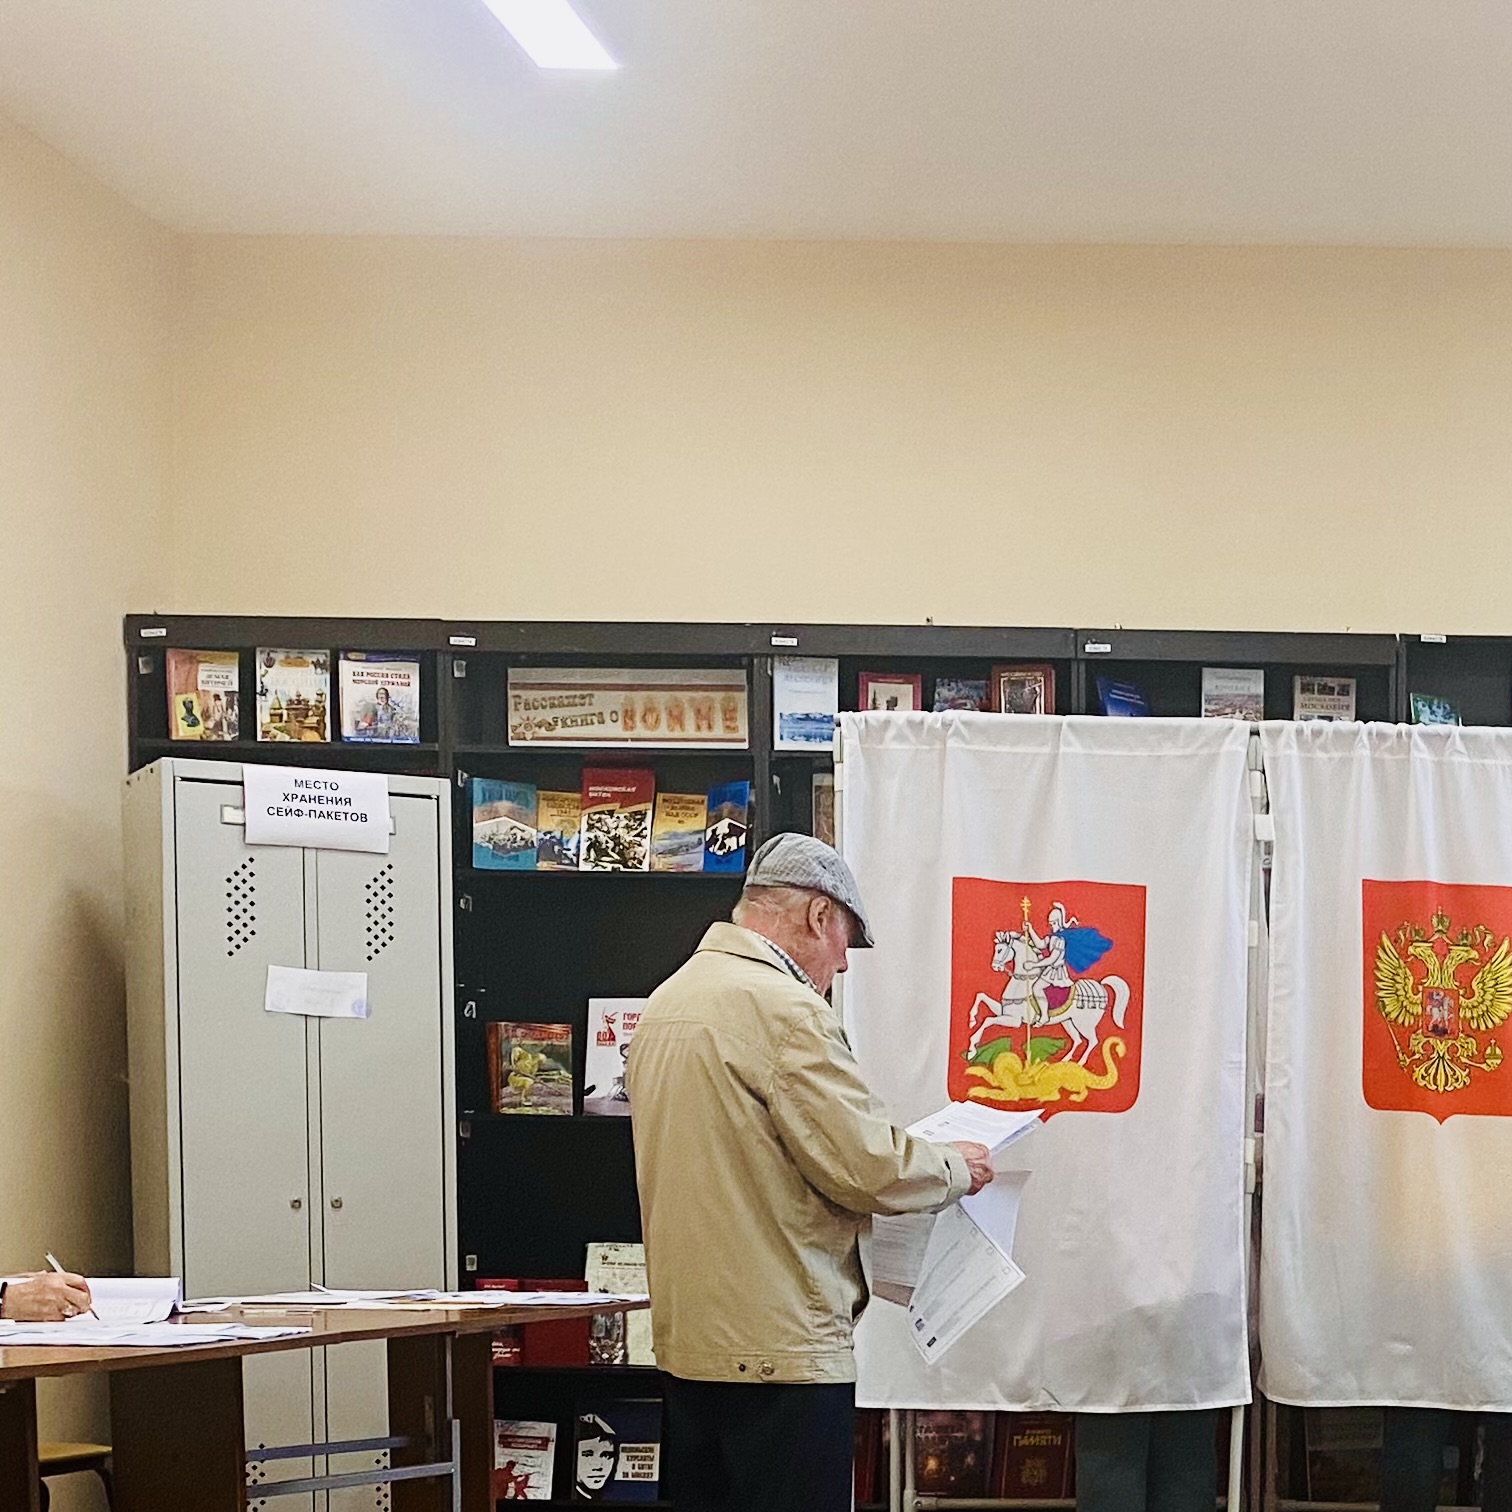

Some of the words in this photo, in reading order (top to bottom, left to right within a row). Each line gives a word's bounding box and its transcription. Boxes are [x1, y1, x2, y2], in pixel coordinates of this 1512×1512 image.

[293, 778, 340, 791] МЕСТО
[282, 792, 353, 807] ХРАНЕНИЯ
[266, 805, 368, 823] СЕЙФ-ПАКЕТОВ
